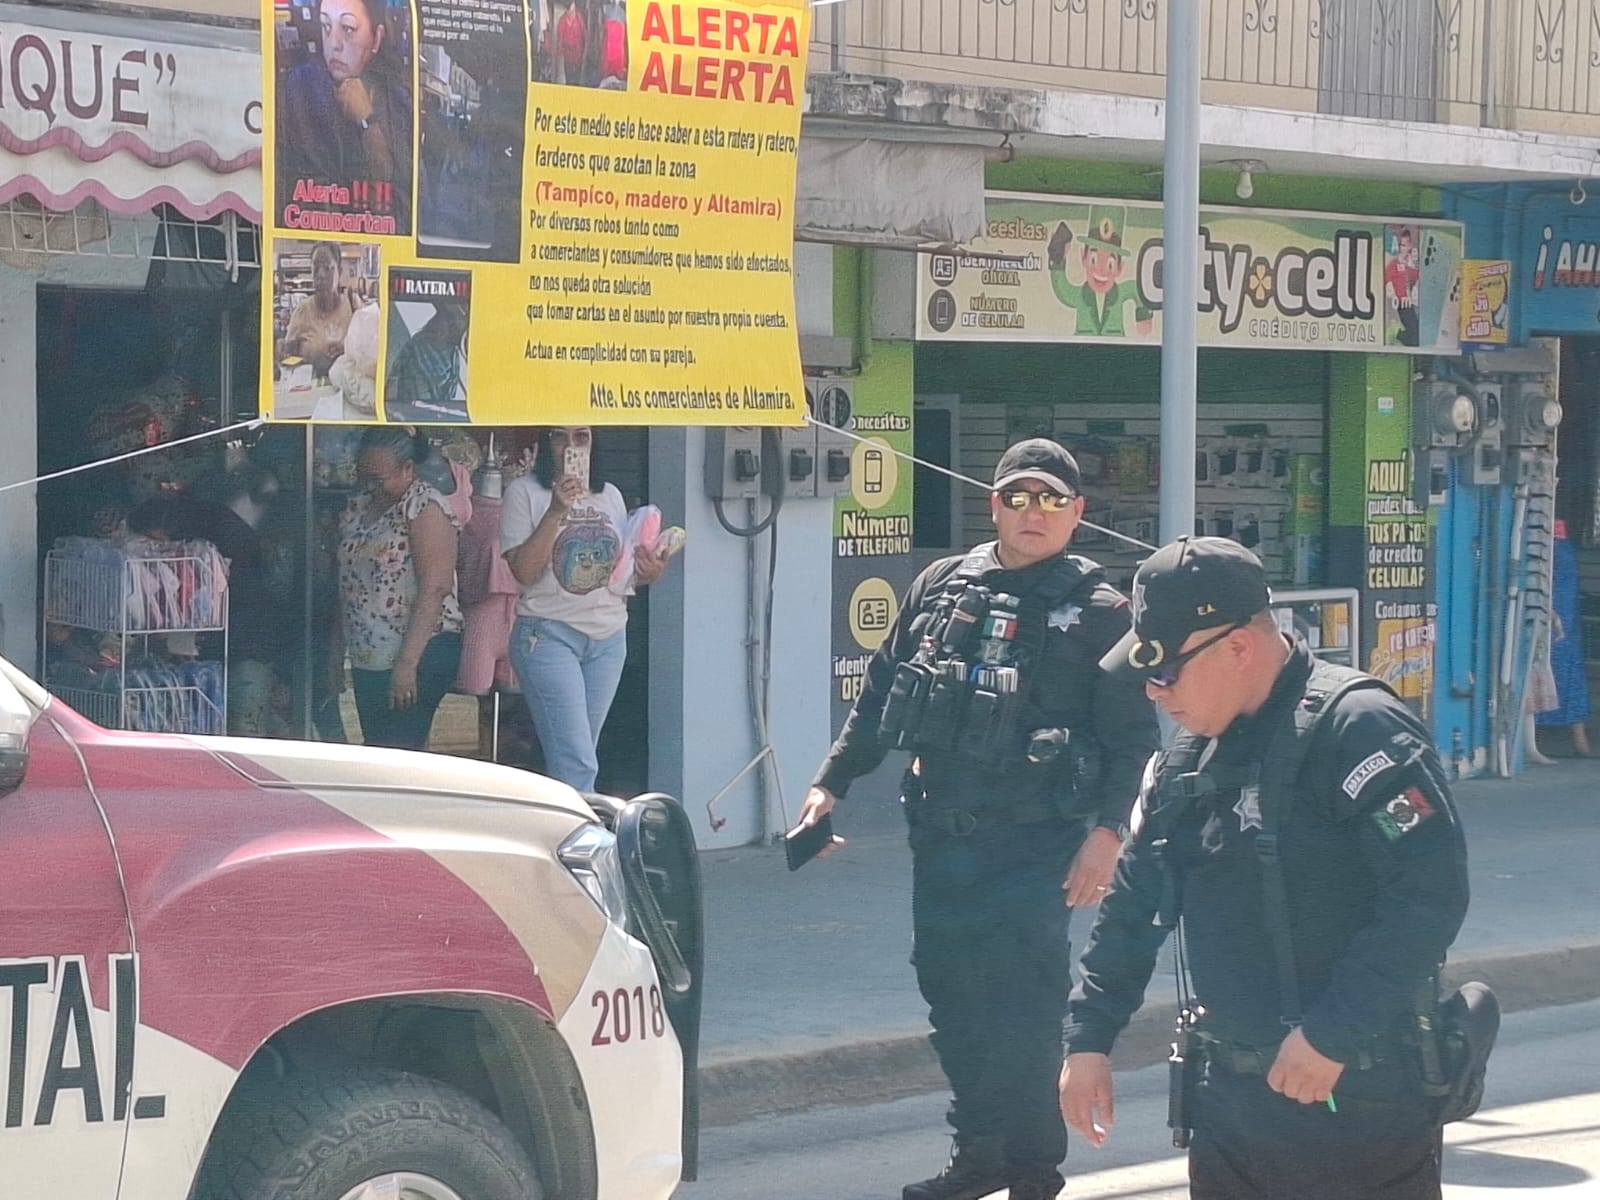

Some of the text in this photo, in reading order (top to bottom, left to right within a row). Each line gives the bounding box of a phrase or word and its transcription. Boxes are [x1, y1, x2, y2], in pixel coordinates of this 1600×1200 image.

[641, 2, 799, 57] ALERTA
[0, 33, 176, 129] QUE”
[639, 51, 794, 106] ALERTA
[534, 107, 552, 132] Por
[555, 111, 577, 134] este
[580, 112, 611, 137] medio
[638, 117, 662, 142] hace
[664, 121, 692, 145] saber
[703, 125, 725, 147] esta
[728, 127, 755, 150] ratera
[757, 131, 764, 157] y
[535, 144, 696, 179] farderos que azotan la zona
[293, 178, 350, 205] Alerta
[625, 190, 689, 210] madero
[693, 197, 703, 216] y
[707, 193, 782, 221] Altamira)
[284, 203, 396, 234] Compartan
[530, 209, 679, 237] Por diversos robos tanto como
[985, 216, 1048, 241] cesitas:
[531, 243, 536, 260] a
[539, 241, 600, 263] comerciantes
[602, 247, 609, 269] y
[610, 245, 673, 267] consumidores
[675, 252, 692, 273] que
[694, 248, 723, 270] hemos
[725, 250, 744, 271] sido
[529, 272, 651, 298] no nos queda otra solución
[1275, 232, 1374, 317] cell
[526, 304, 544, 325] que
[547, 300, 574, 320] tomar
[576, 302, 606, 321] cartas
[609, 307, 620, 322] en
[623, 304, 631, 322] el
[634, 305, 665, 324] asunto
[668, 311, 682, 330] por
[685, 307, 721, 326] nuestra
[723, 309, 752, 333] propia
[961, 312, 977, 327] DE
[1249, 316, 1376, 343] CRÉDITO TOTAL
[525, 339, 696, 368] Actua en complicidad con su pareja.
[589, 382, 795, 410] Atte. Los comerciantes de Altamira.
[842, 510, 909, 537] Número
[1369, 523, 1389, 544] TUS
[838, 538, 854, 557] DE
[1369, 545, 1382, 564] de
[592, 984, 665, 1046] 2018
